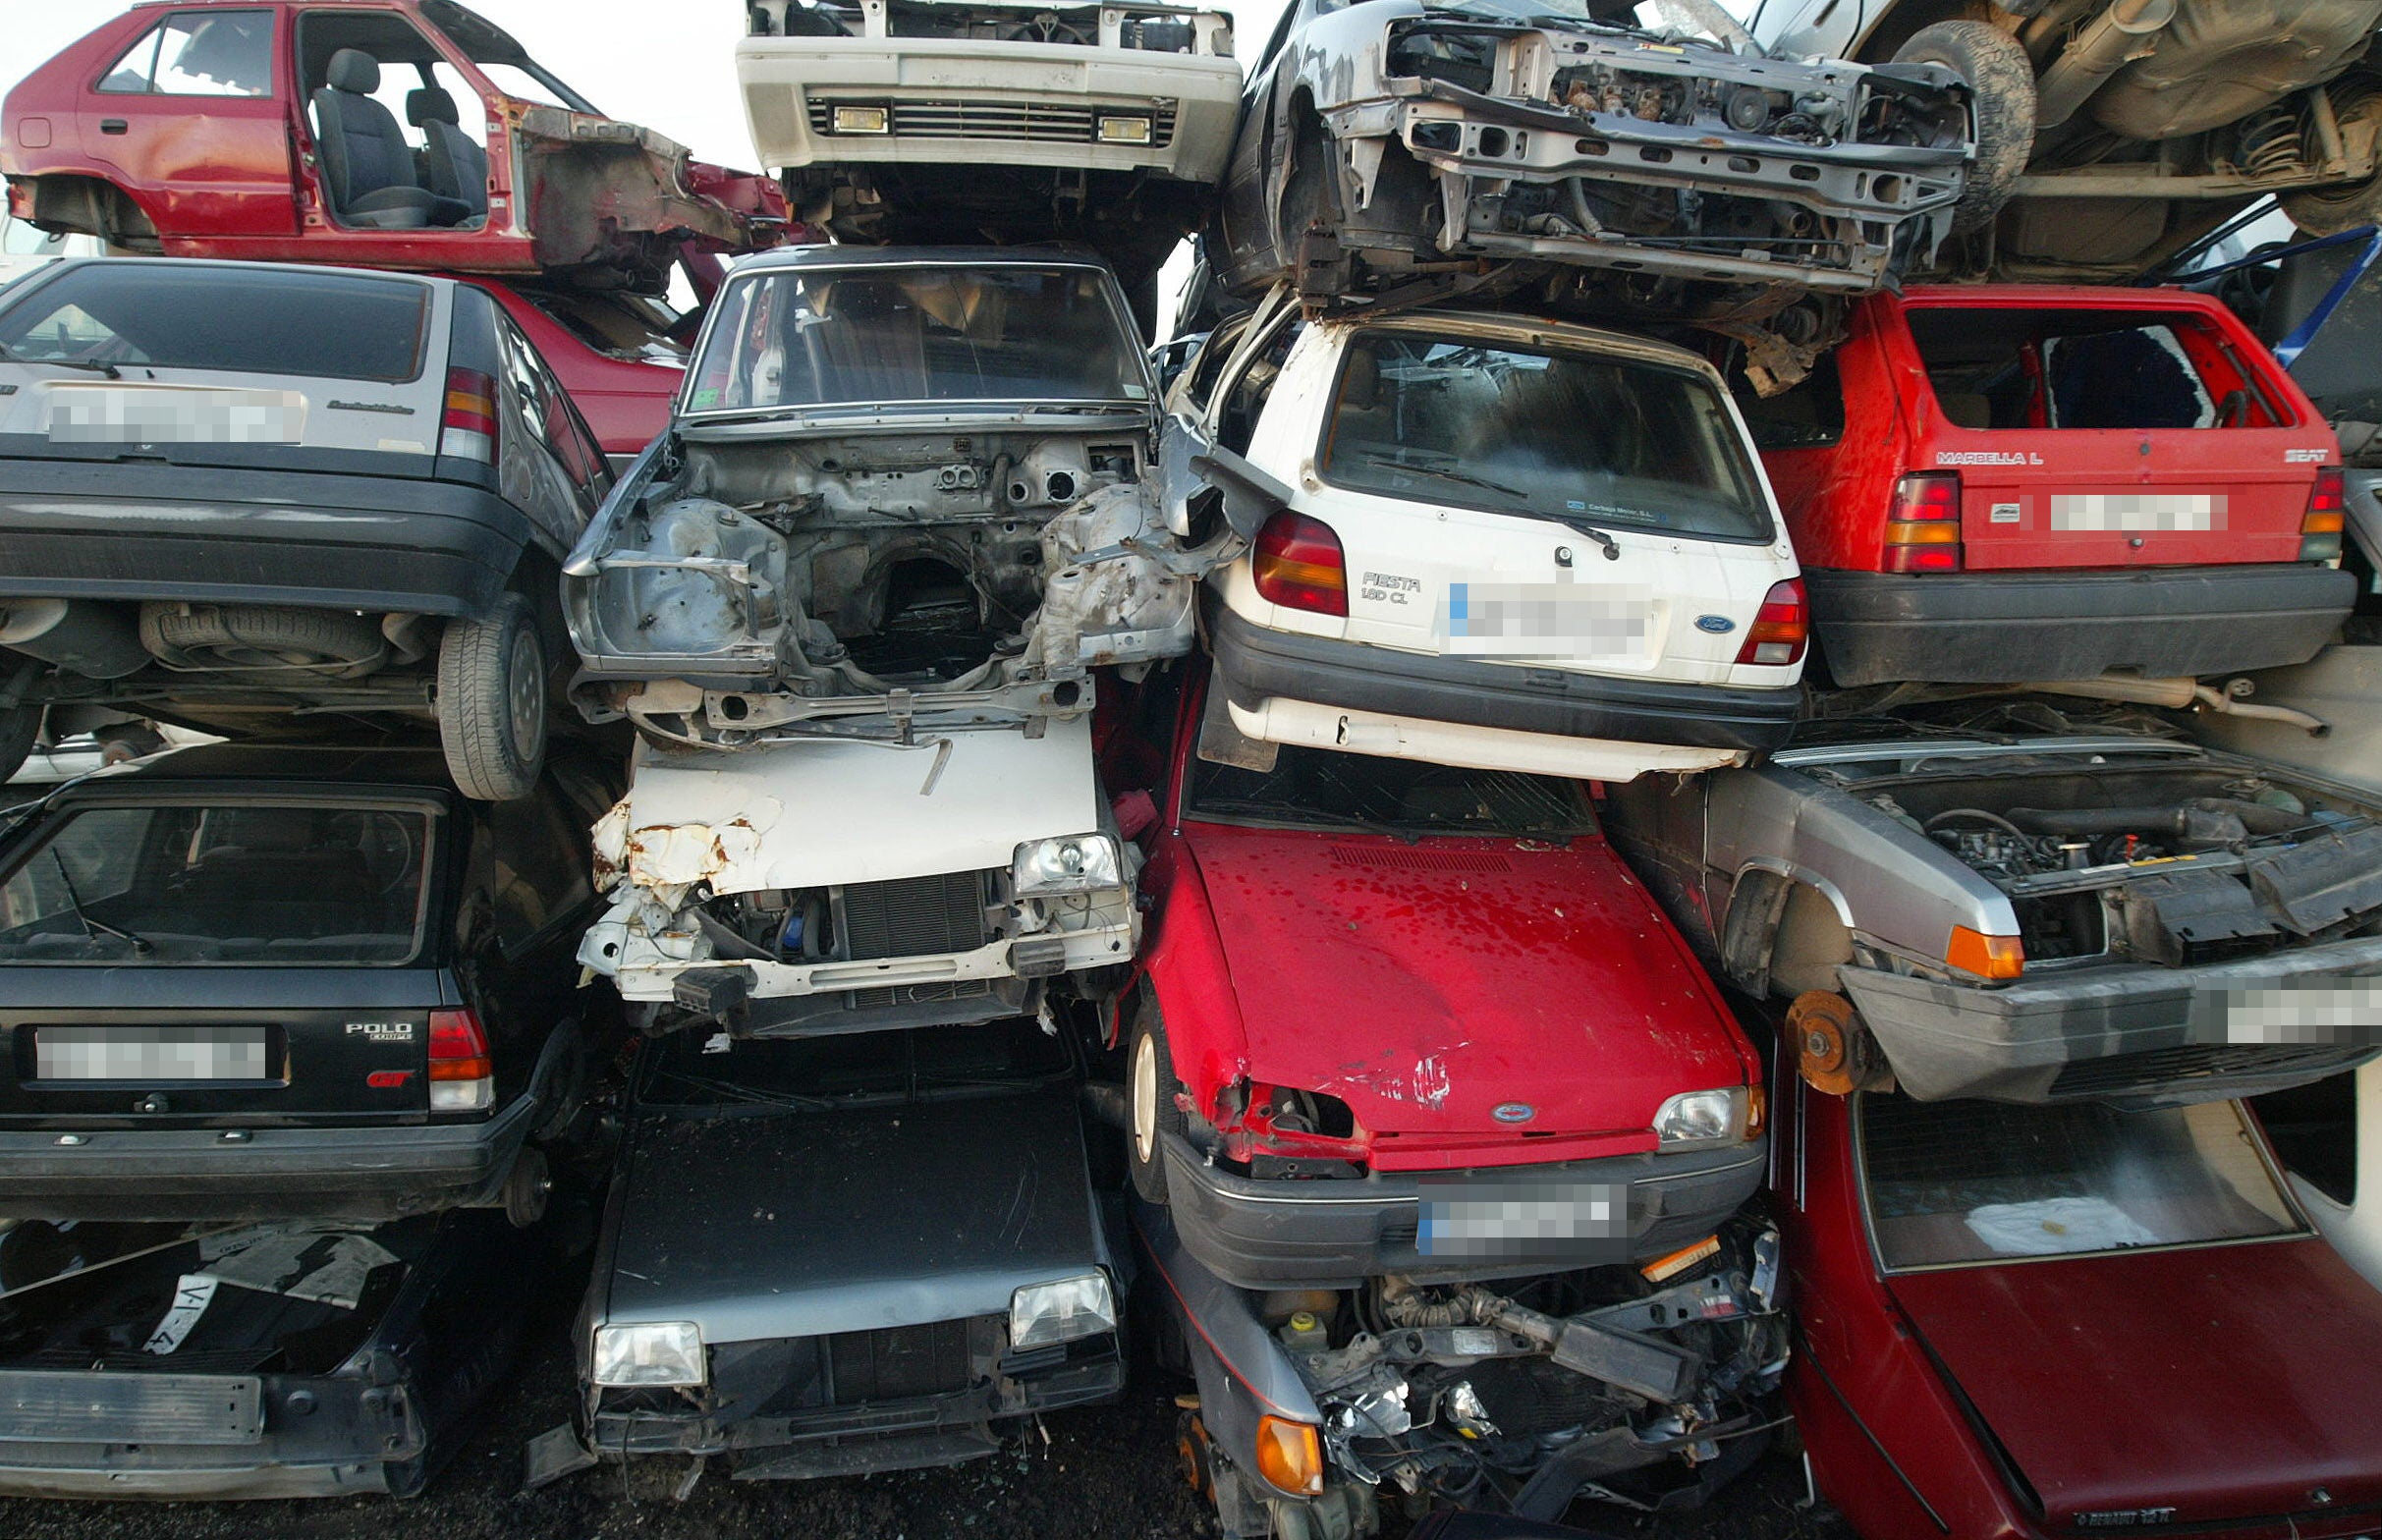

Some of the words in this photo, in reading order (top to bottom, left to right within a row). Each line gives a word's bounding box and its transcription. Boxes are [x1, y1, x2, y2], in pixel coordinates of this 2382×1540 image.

[1936, 452, 2026, 465] MARBELLA
[2029, 452, 2043, 465] L
[2285, 449, 2329, 463] SEAT
[1362, 572, 1420, 592] FIESTA
[1390, 591, 1409, 605] CL
[346, 1023, 412, 1034] POLO
[366, 1070, 415, 1088] GT
